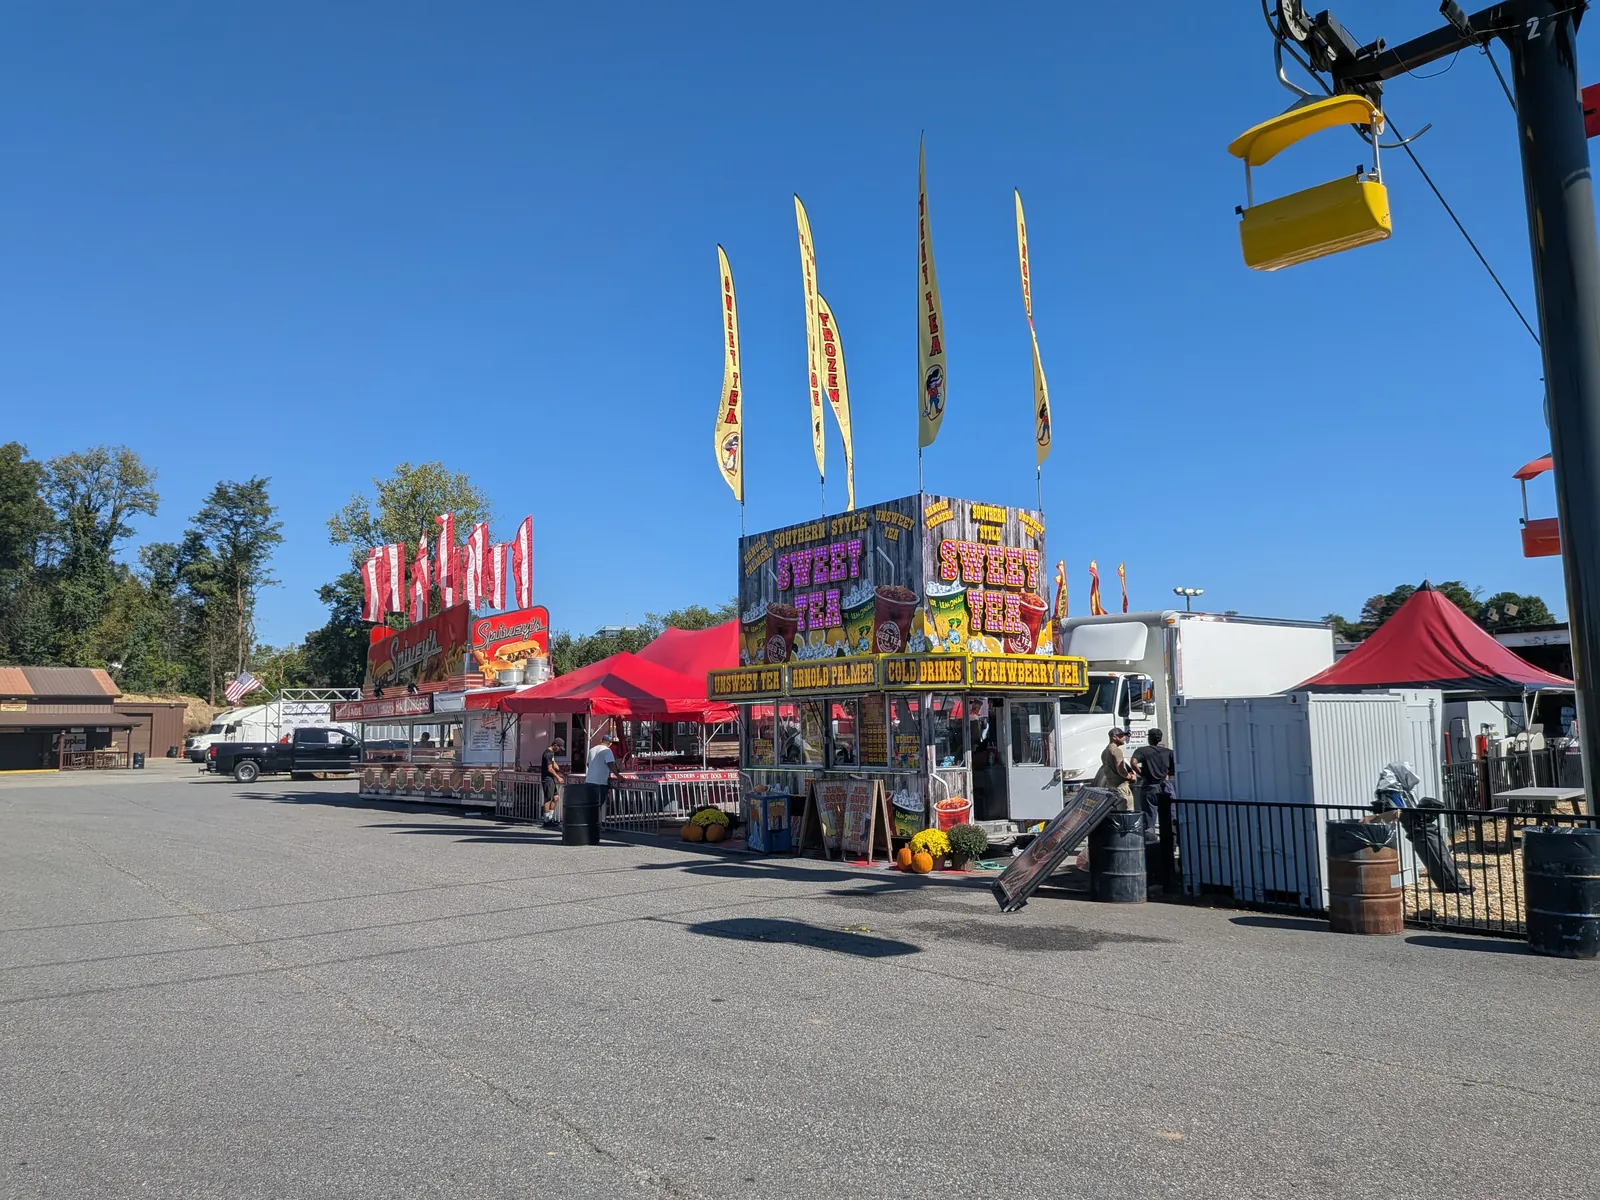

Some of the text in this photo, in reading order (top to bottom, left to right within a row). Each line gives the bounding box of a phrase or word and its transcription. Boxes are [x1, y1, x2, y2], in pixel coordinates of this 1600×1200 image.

[1526, 16, 1540, 40] 2
[926, 291, 942, 358] TEA
[725, 275, 738, 425] SWEET TEA
[819, 312, 840, 403] FROZEN
[875, 509, 916, 532] UNSWEET
[924, 500, 949, 517] ARNOLD
[926, 510, 955, 530] PALMERS
[972, 504, 1007, 524] SOUTHERN
[773, 512, 868, 550] SOUTHERN STYLE
[884, 526, 900, 541] TEA
[980, 524, 1001, 541] STYLE
[743, 535, 768, 566] ARNOLD
[744, 546, 773, 579] PALMERS
[940, 539, 1039, 589] SWEET
[777, 538, 863, 591] SWEET
[794, 588, 843, 632] TEA
[967, 589, 1022, 634] TEA
[714, 671, 780, 693] UNSWEET TEA
[792, 662, 875, 689] ARNOLD PALMER
[888, 660, 962, 682] COLD DRINKS
[976, 660, 1080, 685] STRAWBERRY TEA
